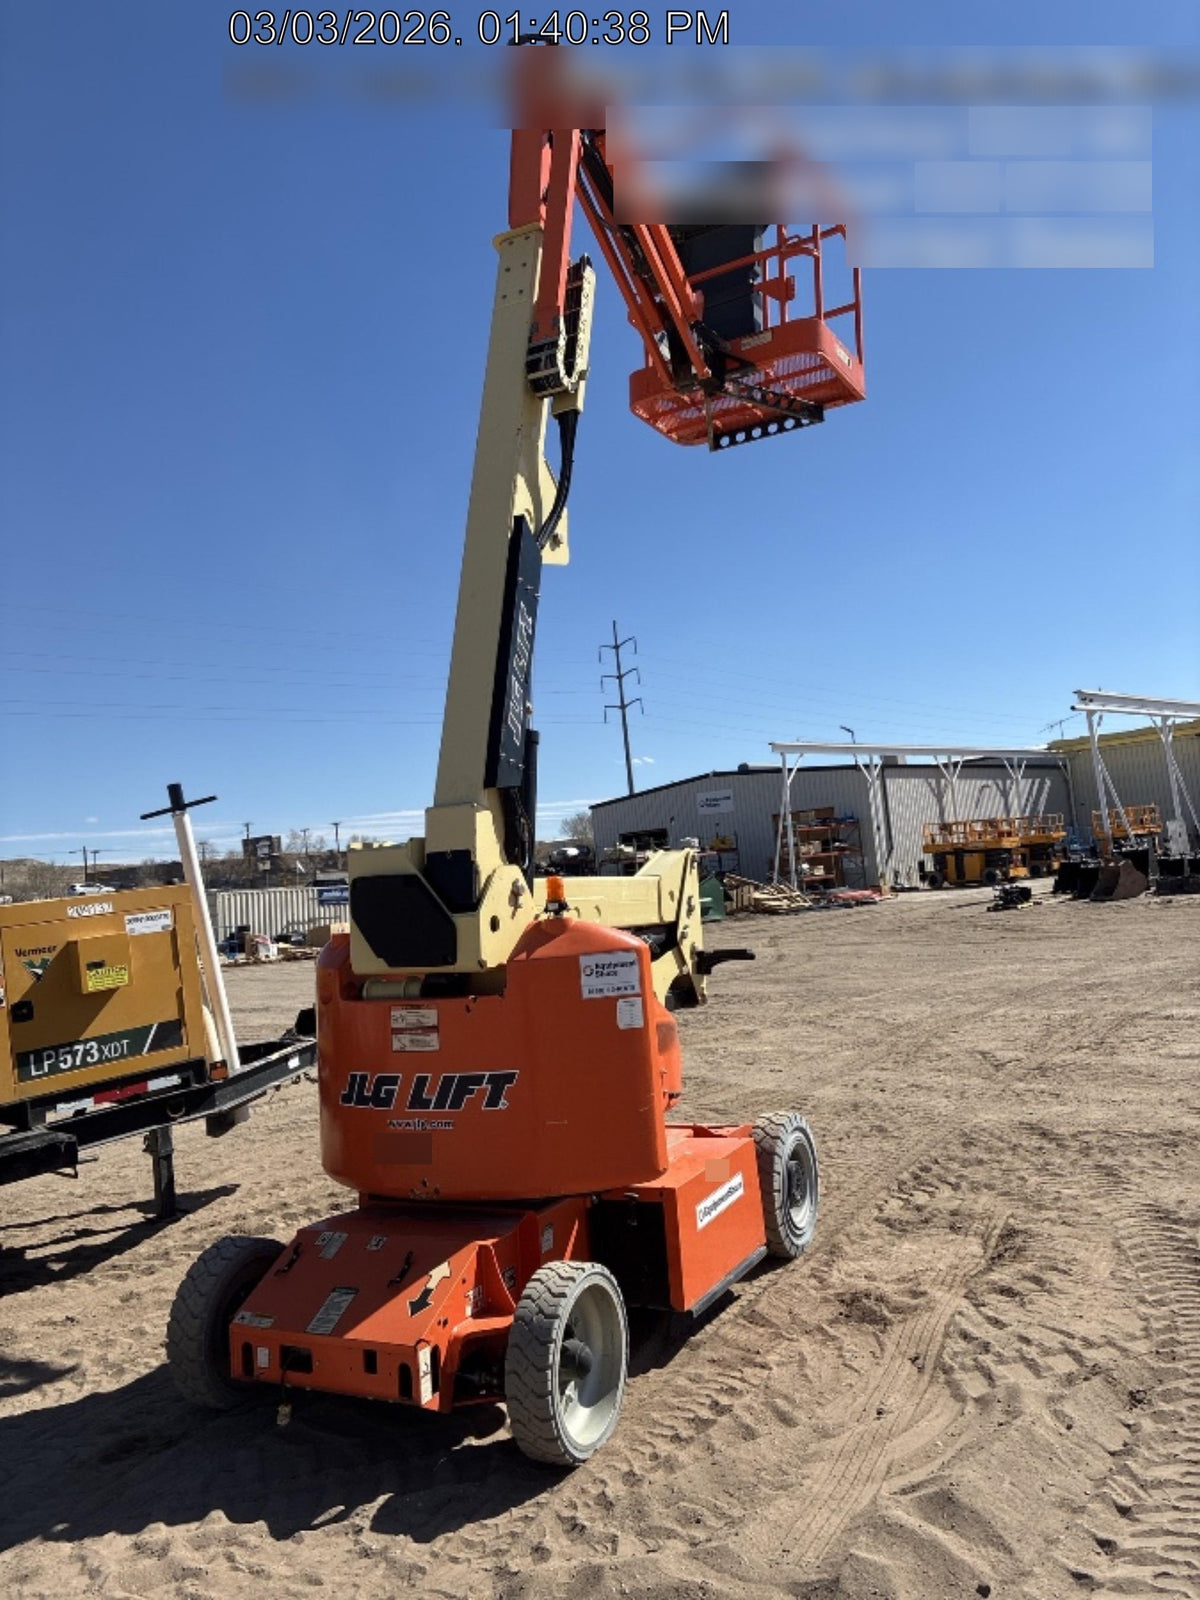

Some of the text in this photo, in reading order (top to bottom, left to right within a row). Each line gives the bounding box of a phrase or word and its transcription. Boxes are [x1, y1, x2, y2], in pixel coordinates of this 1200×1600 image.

[14, 945, 58, 958] Vermeer
[339, 1069, 519, 1111] JLG LIFT
